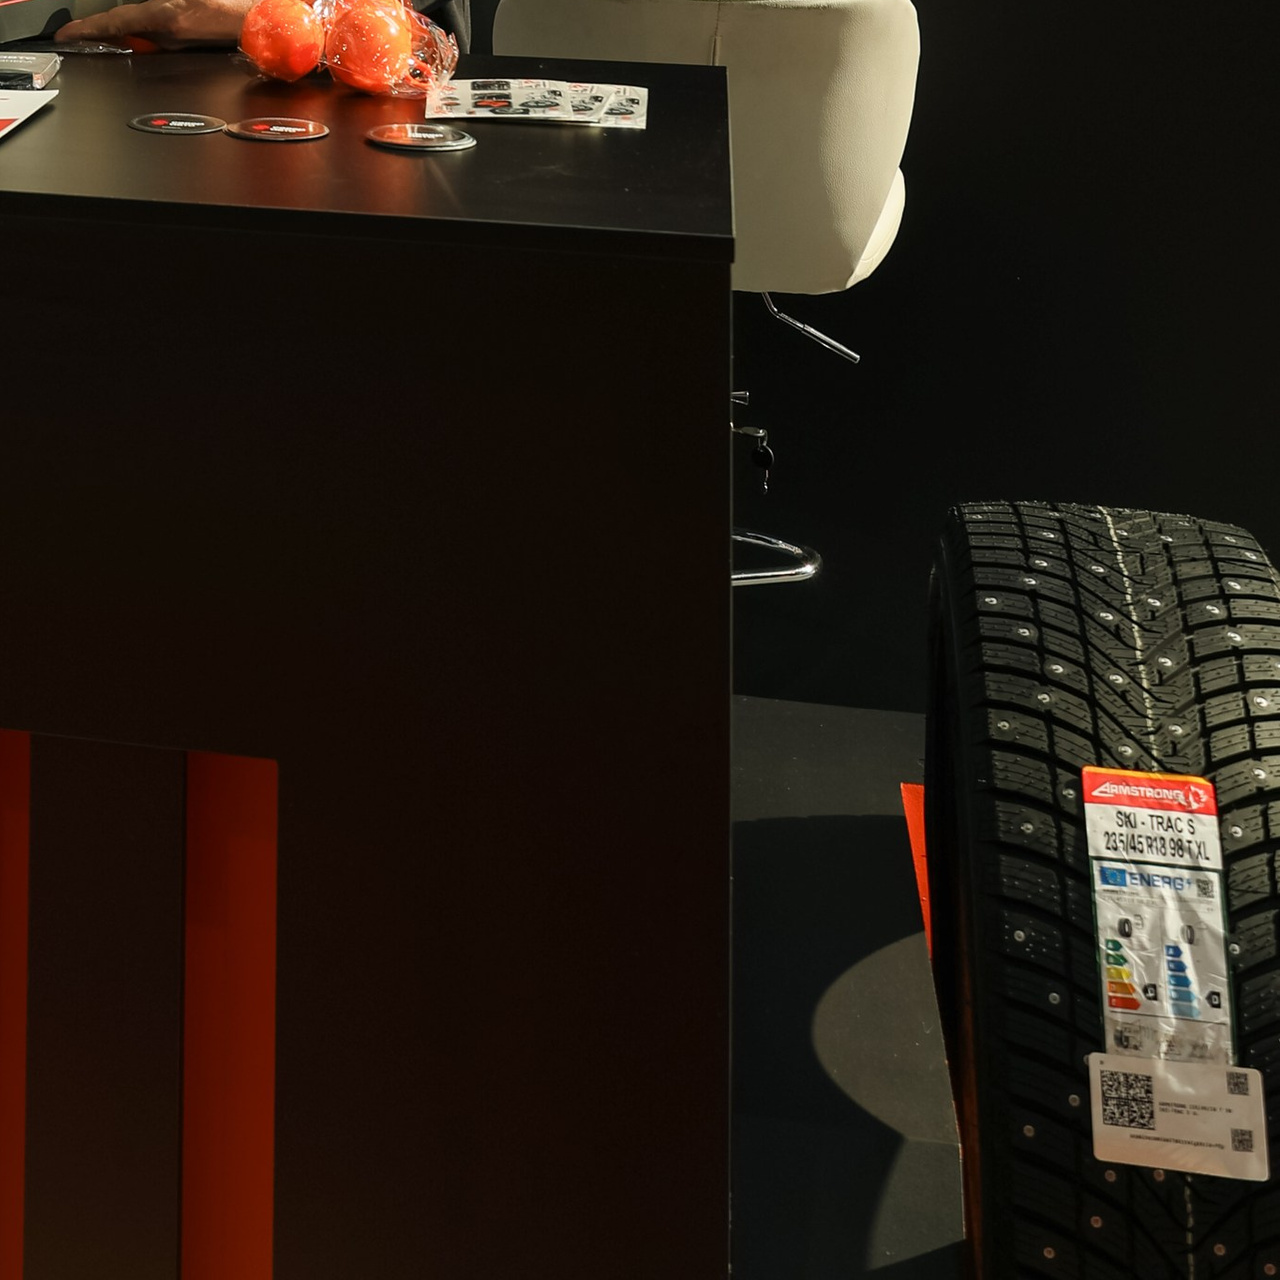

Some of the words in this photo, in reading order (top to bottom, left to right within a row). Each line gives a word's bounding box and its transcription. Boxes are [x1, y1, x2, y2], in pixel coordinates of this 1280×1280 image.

[1091, 781, 1185, 801] ARMSTRONG
[1116, 810, 1137, 829] SKI
[1148, 813, 1184, 834] TRAC
[1187, 819, 1196, 836] S
[1104, 831, 1144, 855] 235/45
[1146, 835, 1167, 857] R18
[1170, 838, 1184, 859] 98
[1195, 841, 1211, 861] XL
